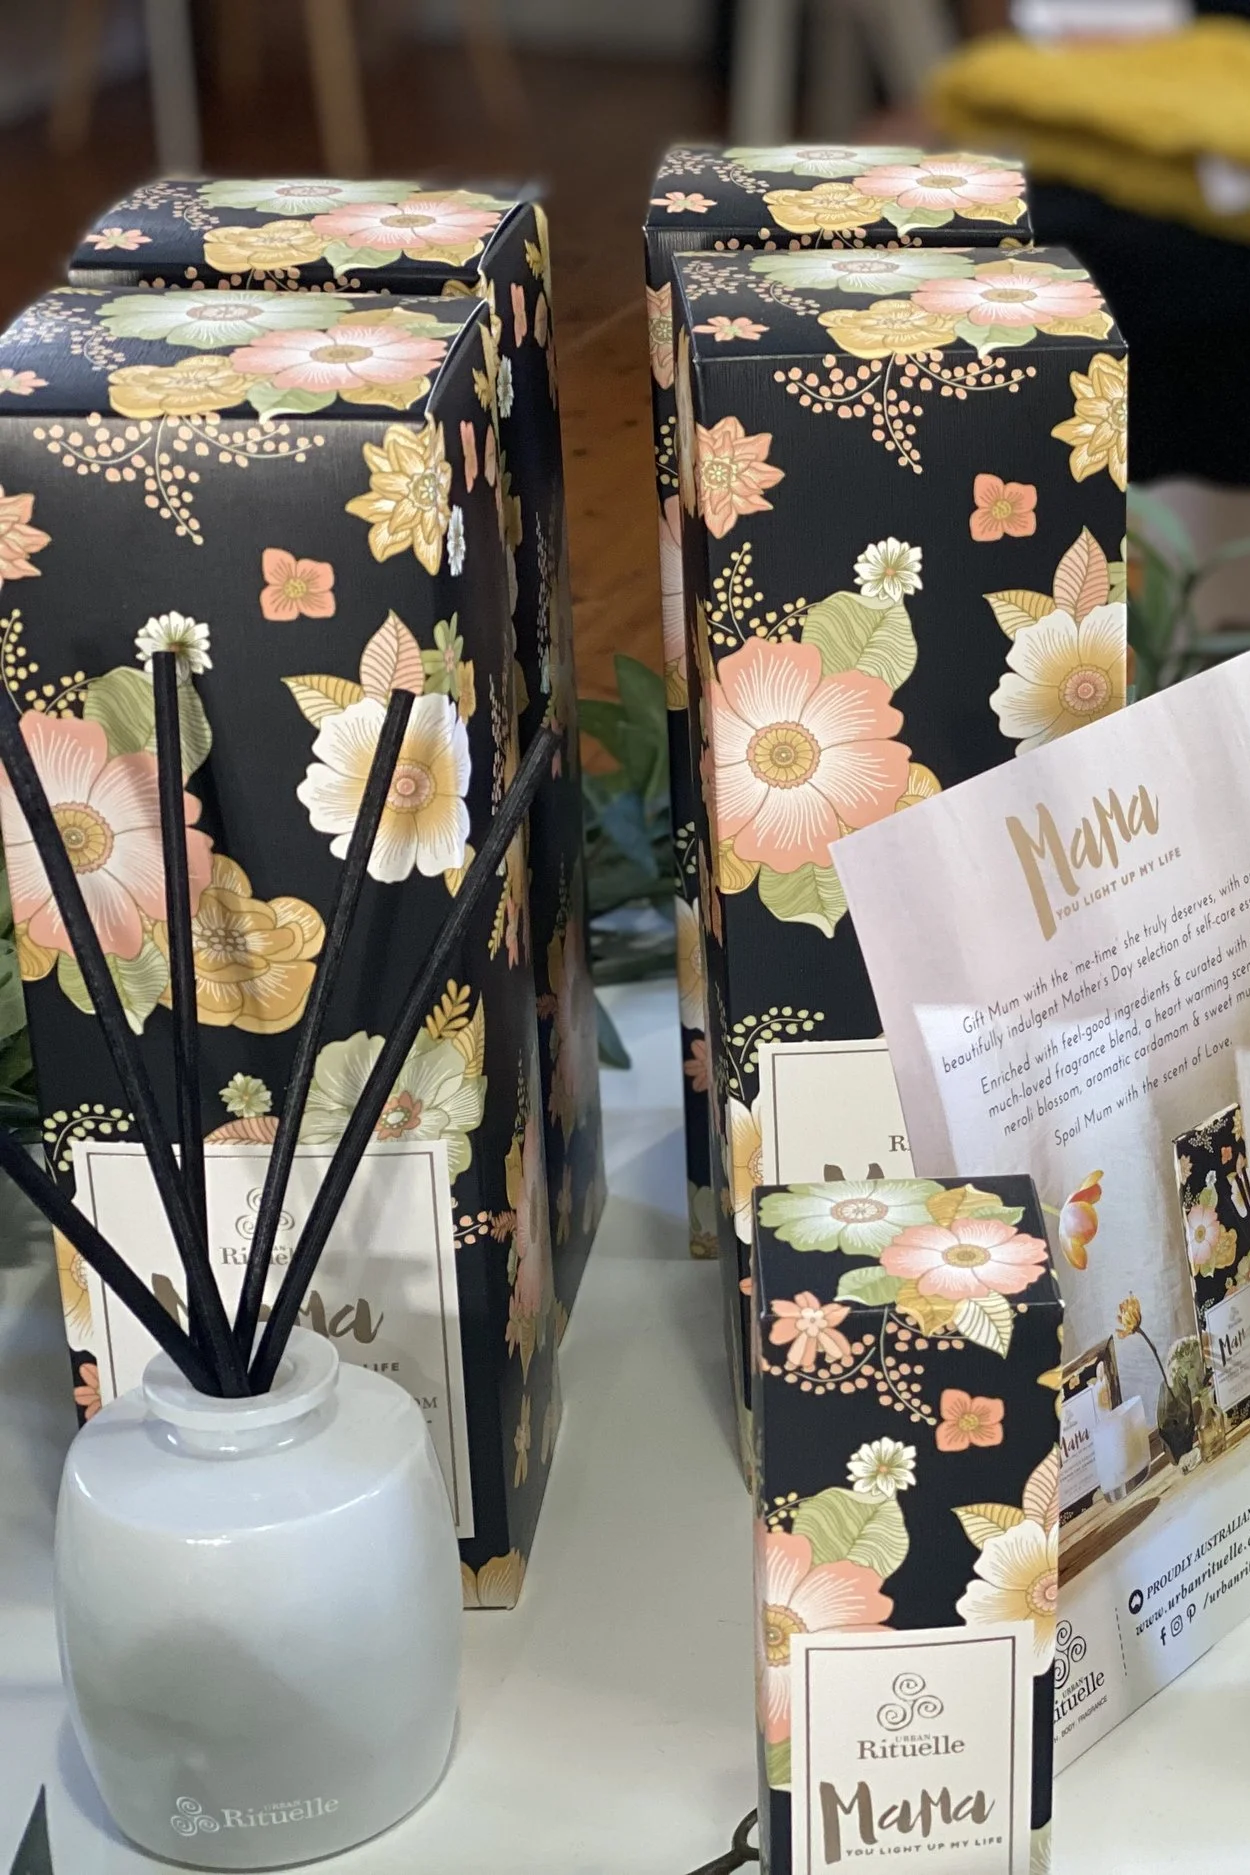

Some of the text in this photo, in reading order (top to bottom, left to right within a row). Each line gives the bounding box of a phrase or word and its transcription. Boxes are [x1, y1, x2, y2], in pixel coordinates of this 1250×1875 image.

[1056, 847, 1182, 920] YOU LIGHT UP MY LIFE
[963, 1011, 984, 1034] Gift
[988, 998, 1019, 1020] Mum
[1024, 977, 1048, 1001] with
[1051, 970, 1068, 988] the
[1123, 930, 1140, 949] she
[1144, 914, 1167, 937] truly
[1171, 893, 1216, 923] deserves,
[1219, 874, 1240, 897] with
[942, 1028, 1004, 1073] beautifully
[1007, 1002, 1058, 1039] indulgent
[1111, 960, 1133, 982] Day
[1138, 938, 1179, 968] selection
[1182, 923, 1191, 942] of
[1196, 907, 1236, 936] self-care
[981, 1052, 1030, 1094] Enriched
[1034, 1040, 1058, 1064] with
[1062, 1009, 1111, 1050] feel-good
[1114, 980, 1170, 1020] ingredients
[1174, 970, 1181, 987] &
[1186, 946, 1222, 980] curated
[1226, 934, 1247, 957] with
[989, 1068, 1052, 1118] much-loved
[1056, 1043, 1106, 1080] fragrance
[1109, 1019, 1141, 1049] blend,
[1145, 1019, 1151, 1029] a
[1154, 997, 1181, 1024] heart
[1185, 975, 1228, 1006] warming
[1004, 1106, 1033, 1136] neroli
[1036, 1085, 1083, 1116] blossom,
[1086, 1054, 1131, 1089] aromatic
[1134, 1023, 1188, 1060] cardamom
[1192, 1010, 1200, 1027] &
[1205, 995, 1233, 1021] sweet
[1054, 1037, 1232, 1147] Spoil Mum with the scent of Love.
[364, 1362, 400, 1373] IFE
[1147, 1553, 1193, 1599] PROUDLY
[1054, 1672, 1105, 1722] ituelle
[1061, 1694, 1107, 1737] BODY FRAGRANCE
[857, 1735, 965, 1760] Rituelle
[221, 1797, 339, 1828] Rituelle
[846, 1836, 1003, 1857] YOU LIGHT UP MY LIFE
